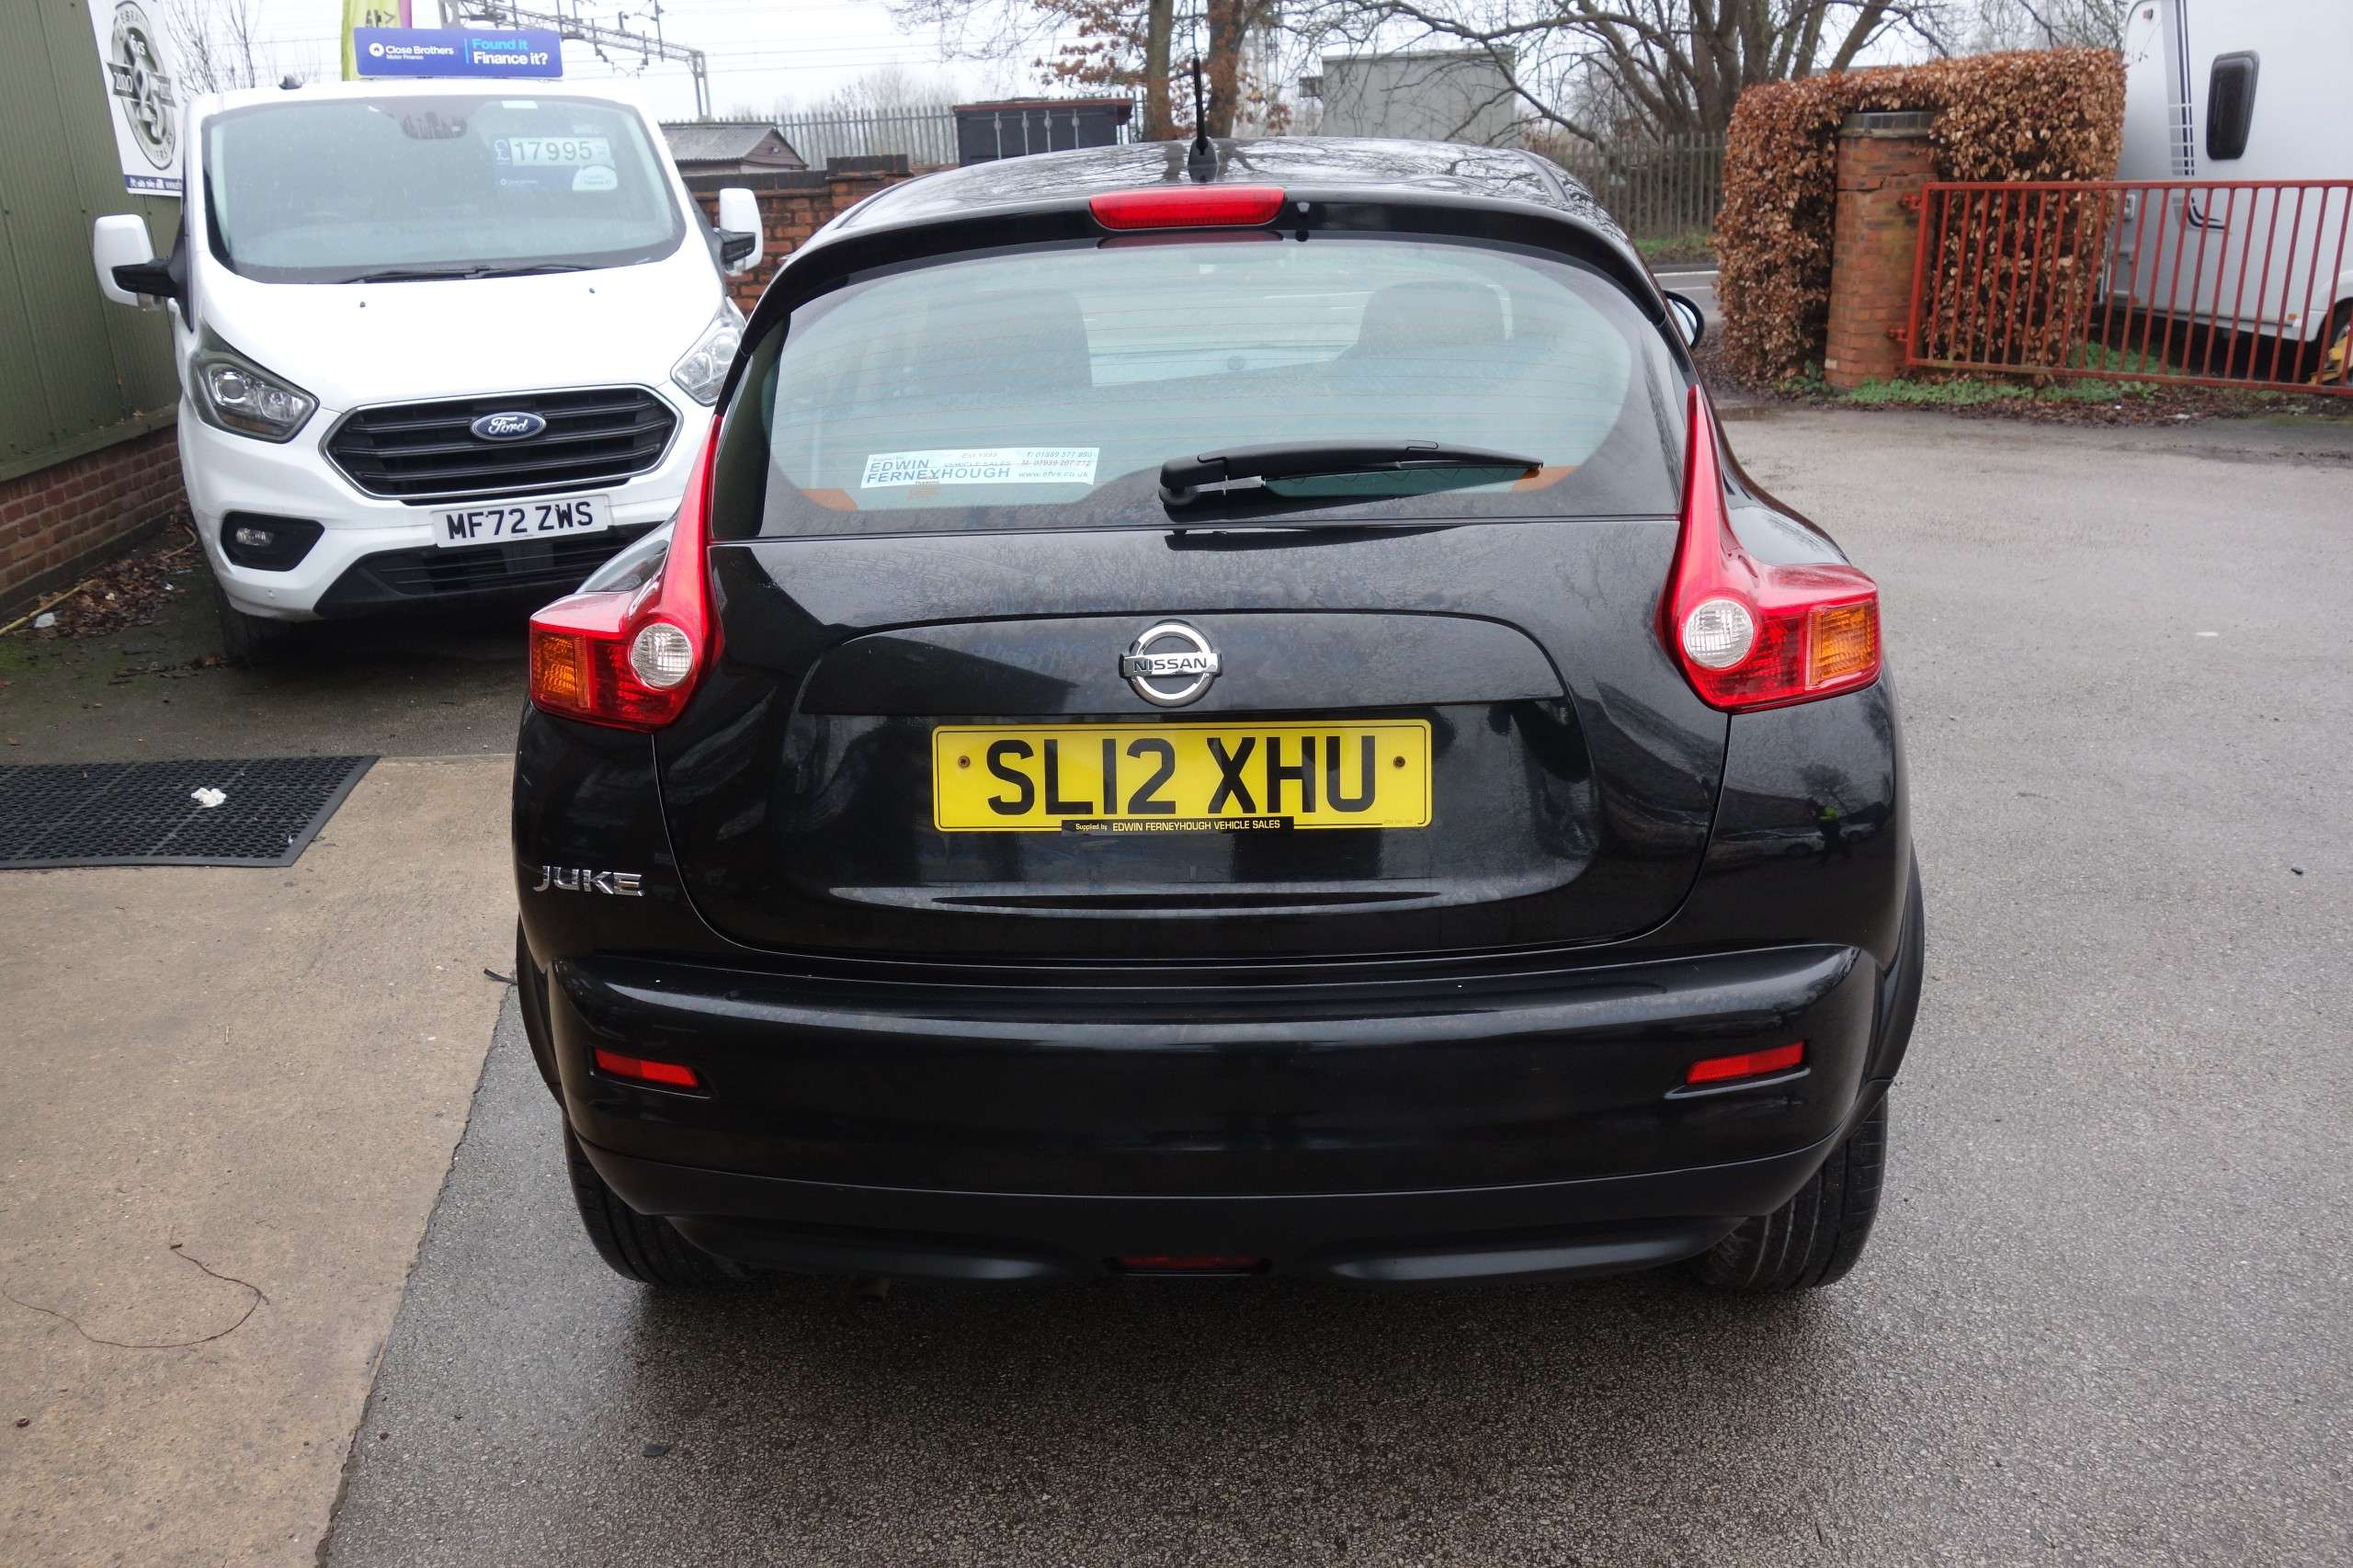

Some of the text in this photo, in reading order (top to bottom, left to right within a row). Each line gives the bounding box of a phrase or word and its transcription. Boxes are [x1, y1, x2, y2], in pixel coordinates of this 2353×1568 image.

[385, 46, 455, 55] Close Brothers
[472, 38, 529, 51] Found it
[473, 51, 549, 65] Finance it?
[488, 416, 529, 435] Ford
[870, 460, 929, 472] EDWIN
[867, 467, 1011, 484] FERNEYHOUGH
[446, 501, 594, 540] MF72 ZWS
[1133, 658, 1208, 672] NISSAN
[986, 734, 1377, 816] SL12 XHU
[1075, 823, 1099, 831] Supplied
[1112, 823, 1142, 832] EDWIN
[1145, 822, 1211, 831] FERNEYHOUGH
[1213, 821, 1249, 830] VEHICLE
[1252, 820, 1280, 829] SALES
[533, 866, 643, 897] JUKE
